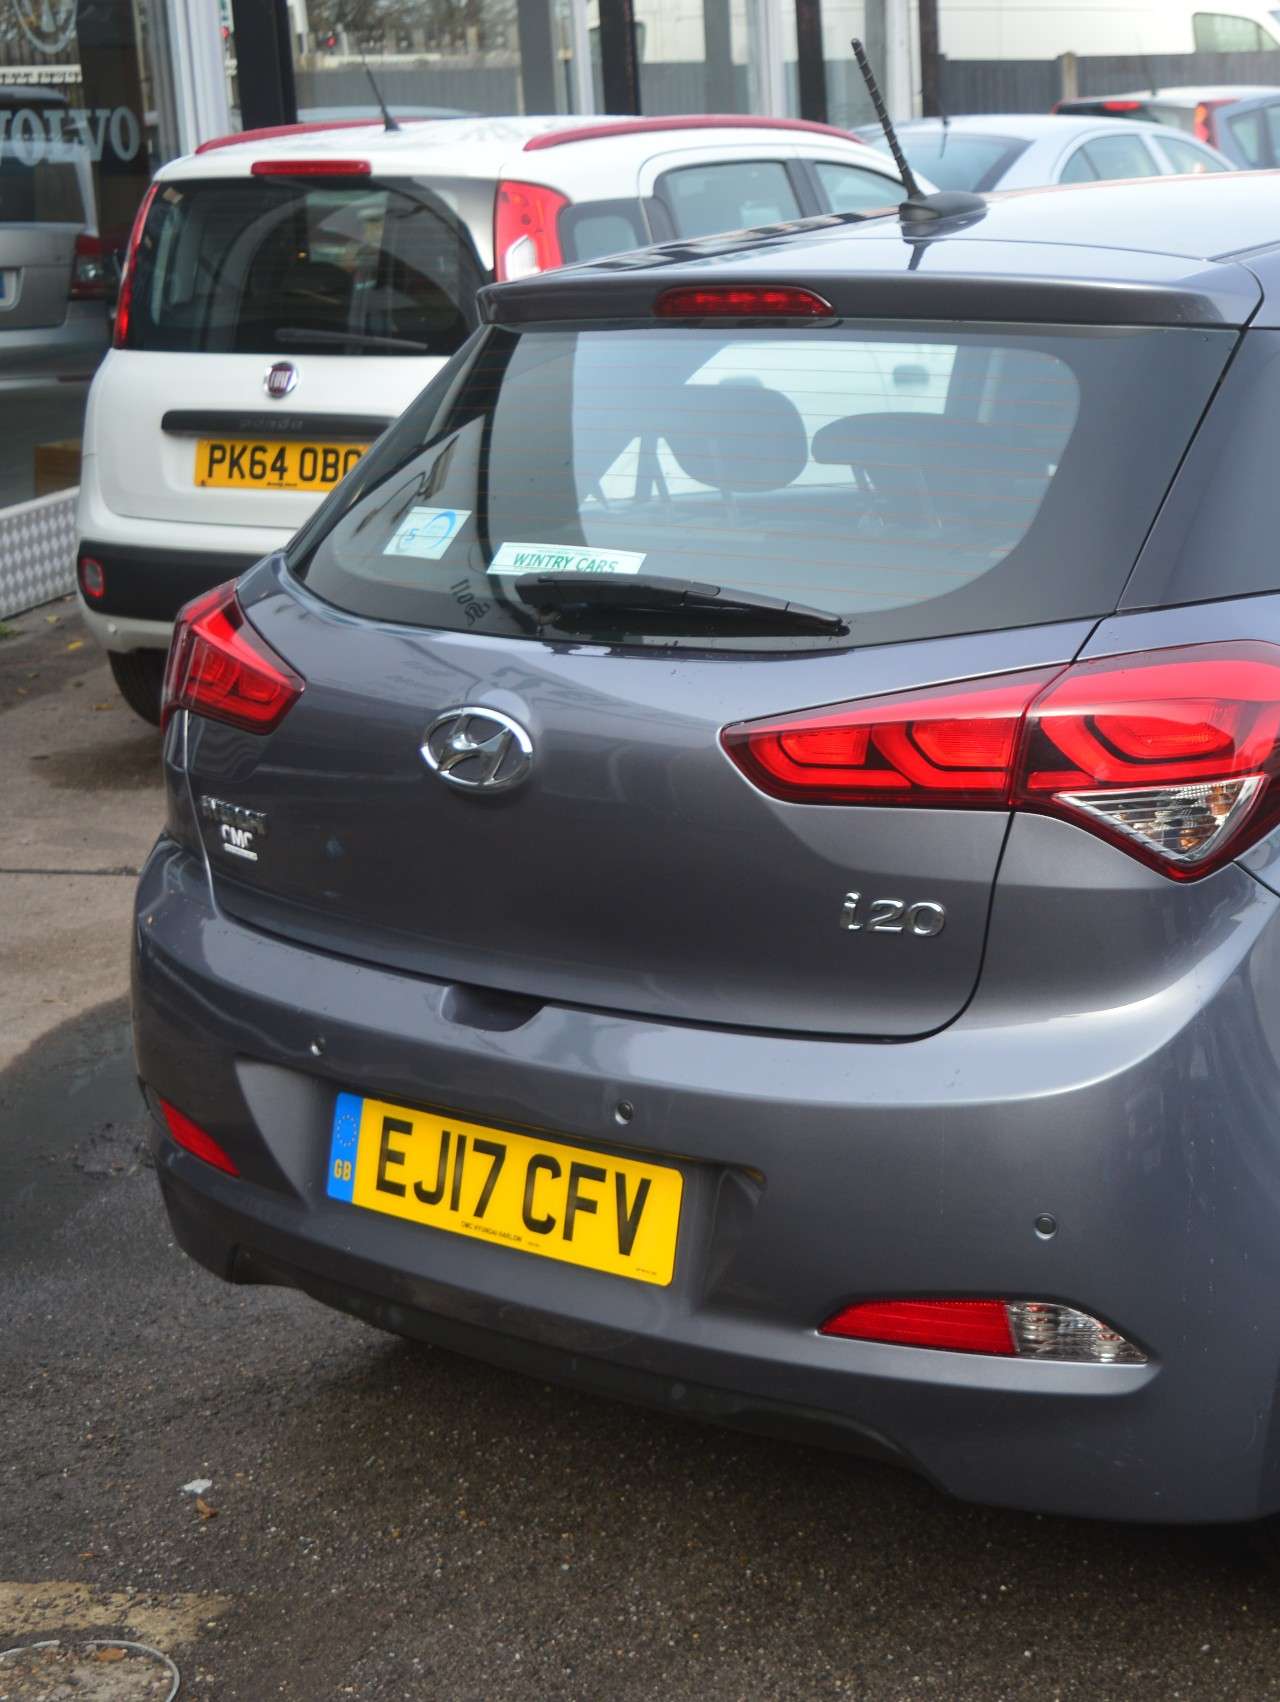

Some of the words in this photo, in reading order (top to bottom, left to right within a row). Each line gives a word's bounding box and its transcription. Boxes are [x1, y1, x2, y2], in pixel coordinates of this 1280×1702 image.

[0, 106, 140, 167] OLVO
[207, 443, 288, 481] PK64
[512, 552, 575, 570] WINTRY
[576, 557, 619, 572] CARS
[841, 891, 945, 936] i20
[333, 1158, 352, 1182] GB
[376, 1116, 507, 1219] EJ17
[522, 1153, 652, 1257] CFV
